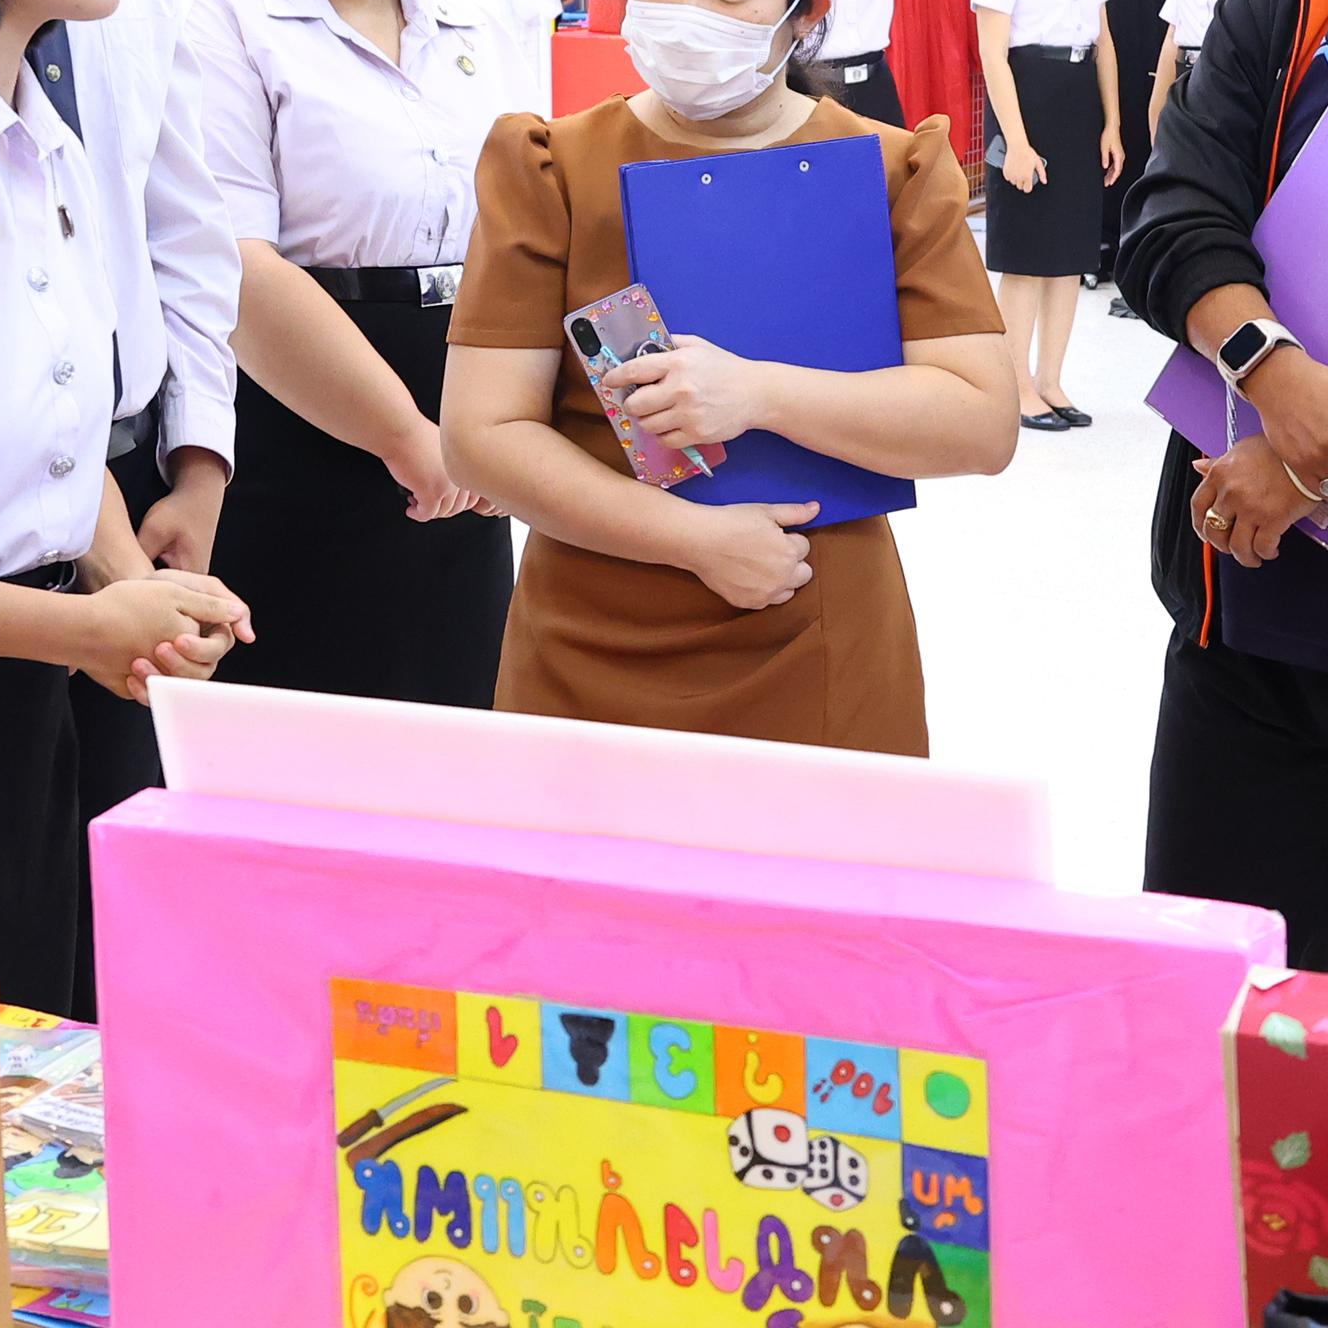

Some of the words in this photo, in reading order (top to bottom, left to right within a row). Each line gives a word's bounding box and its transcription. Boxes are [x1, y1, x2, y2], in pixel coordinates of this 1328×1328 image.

[486, 1005, 519, 1068] 1
[649, 1022, 697, 1100] 3
[912, 1170, 983, 1229] พัก
